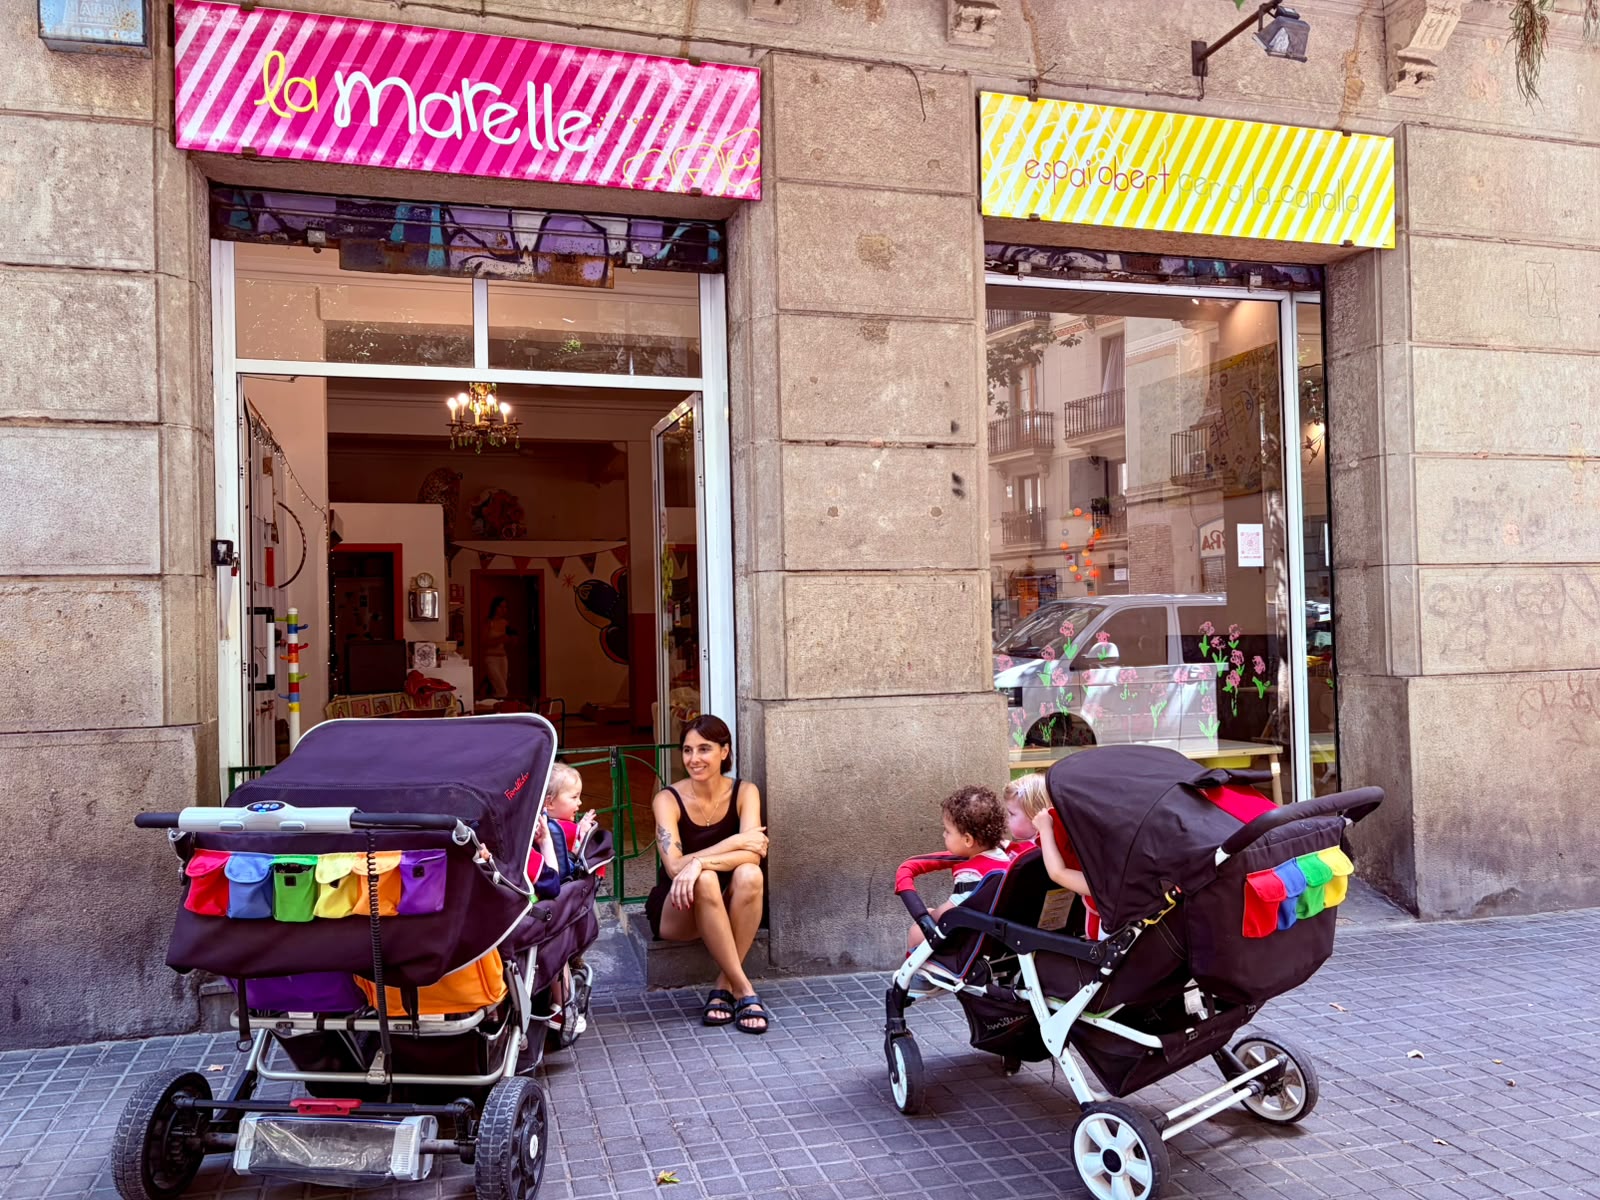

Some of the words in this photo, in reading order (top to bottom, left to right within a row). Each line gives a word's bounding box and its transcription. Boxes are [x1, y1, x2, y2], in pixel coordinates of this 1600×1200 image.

[254, 50, 319, 119] la
[333, 70, 597, 153] marelle
[1025, 159, 1092, 195] espai
[1098, 155, 1171, 195] obert
[1177, 172, 1222, 208] per
[1228, 184, 1244, 204] a
[1251, 170, 1271, 206] la
[1280, 178, 1360, 213] canalla
